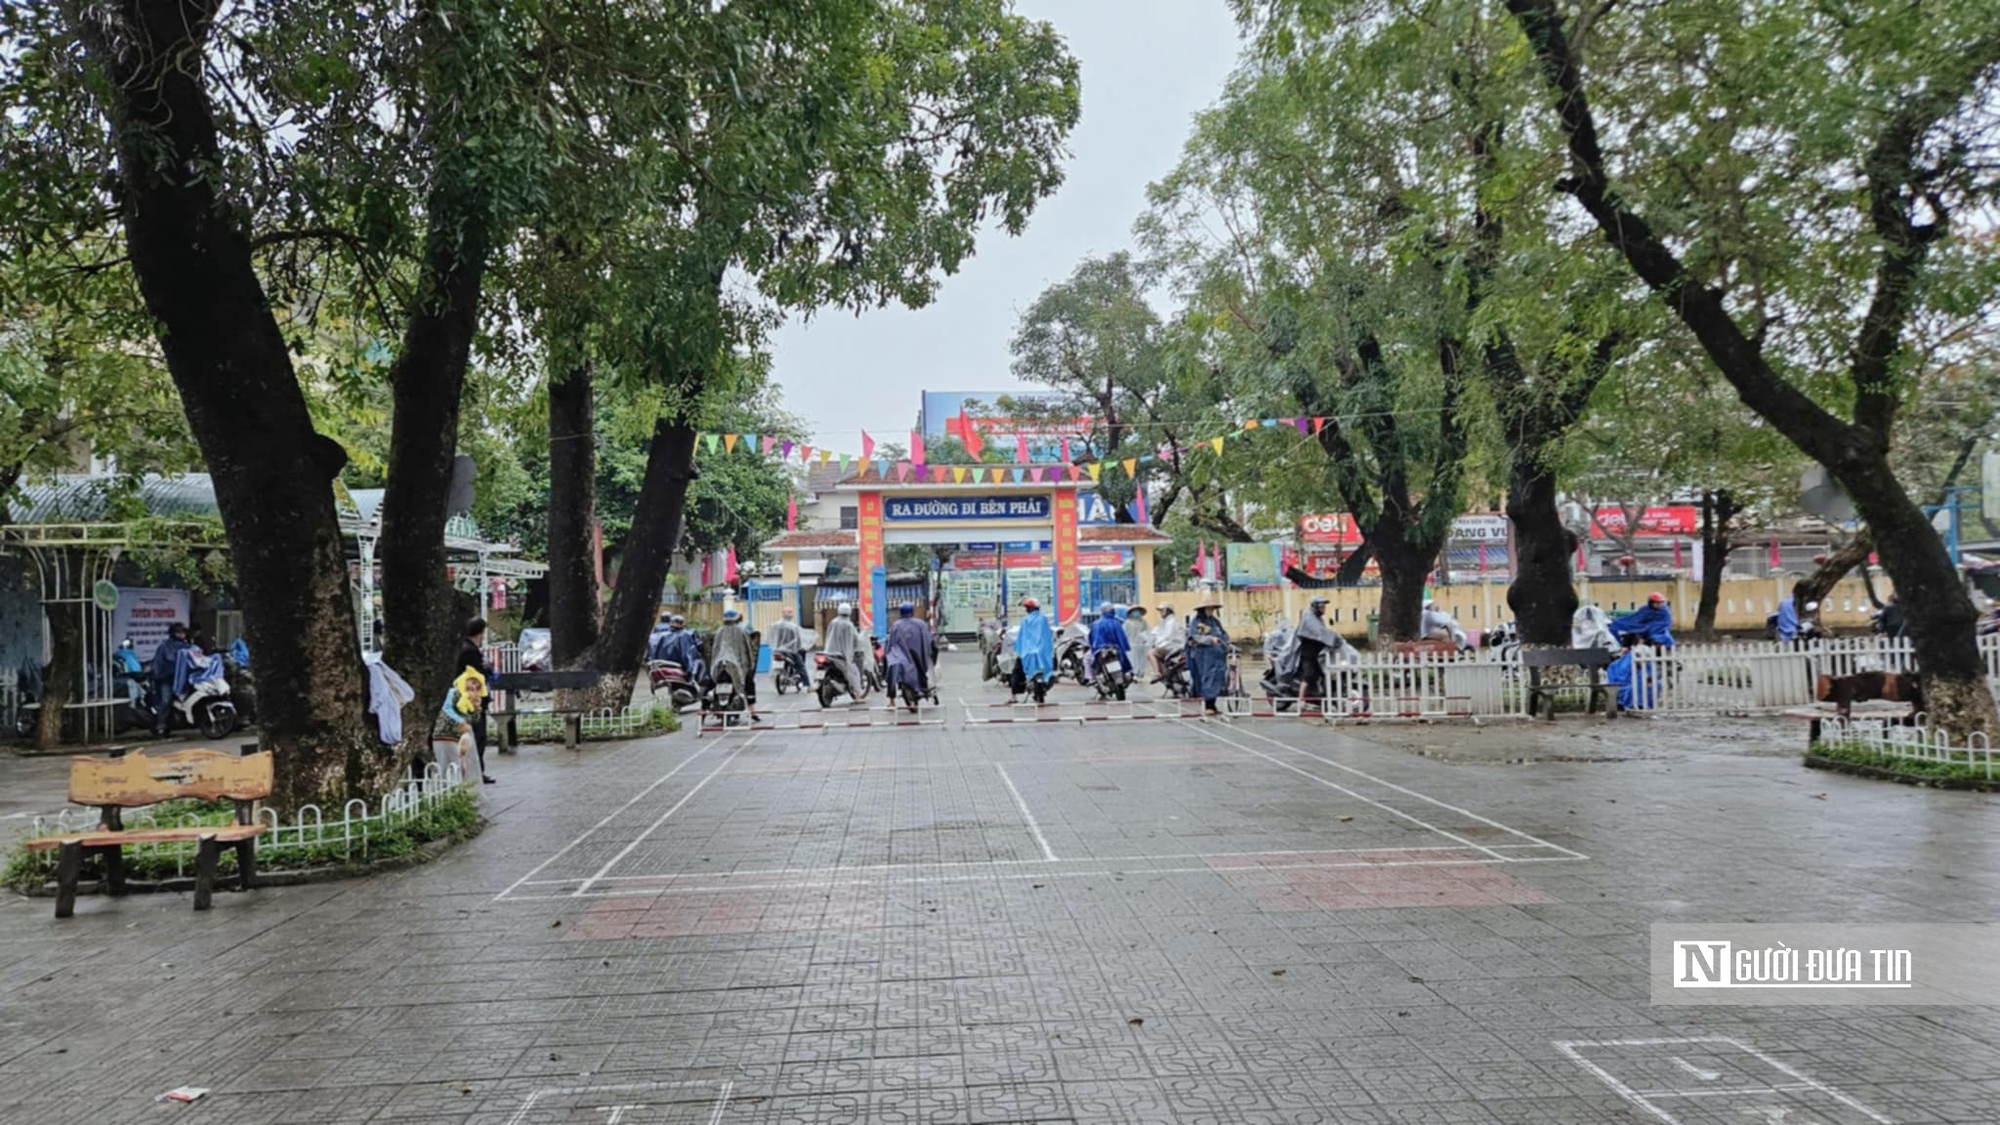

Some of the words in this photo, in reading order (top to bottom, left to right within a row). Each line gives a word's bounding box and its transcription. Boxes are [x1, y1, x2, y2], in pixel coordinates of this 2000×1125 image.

[892, 503, 911, 516] RA
[914, 499, 958, 516] ĐƯỜNG
[962, 502, 977, 515] ĐI
[980, 500, 1006, 515] BÊN
[1010, 496, 1041, 514] PHẢI
